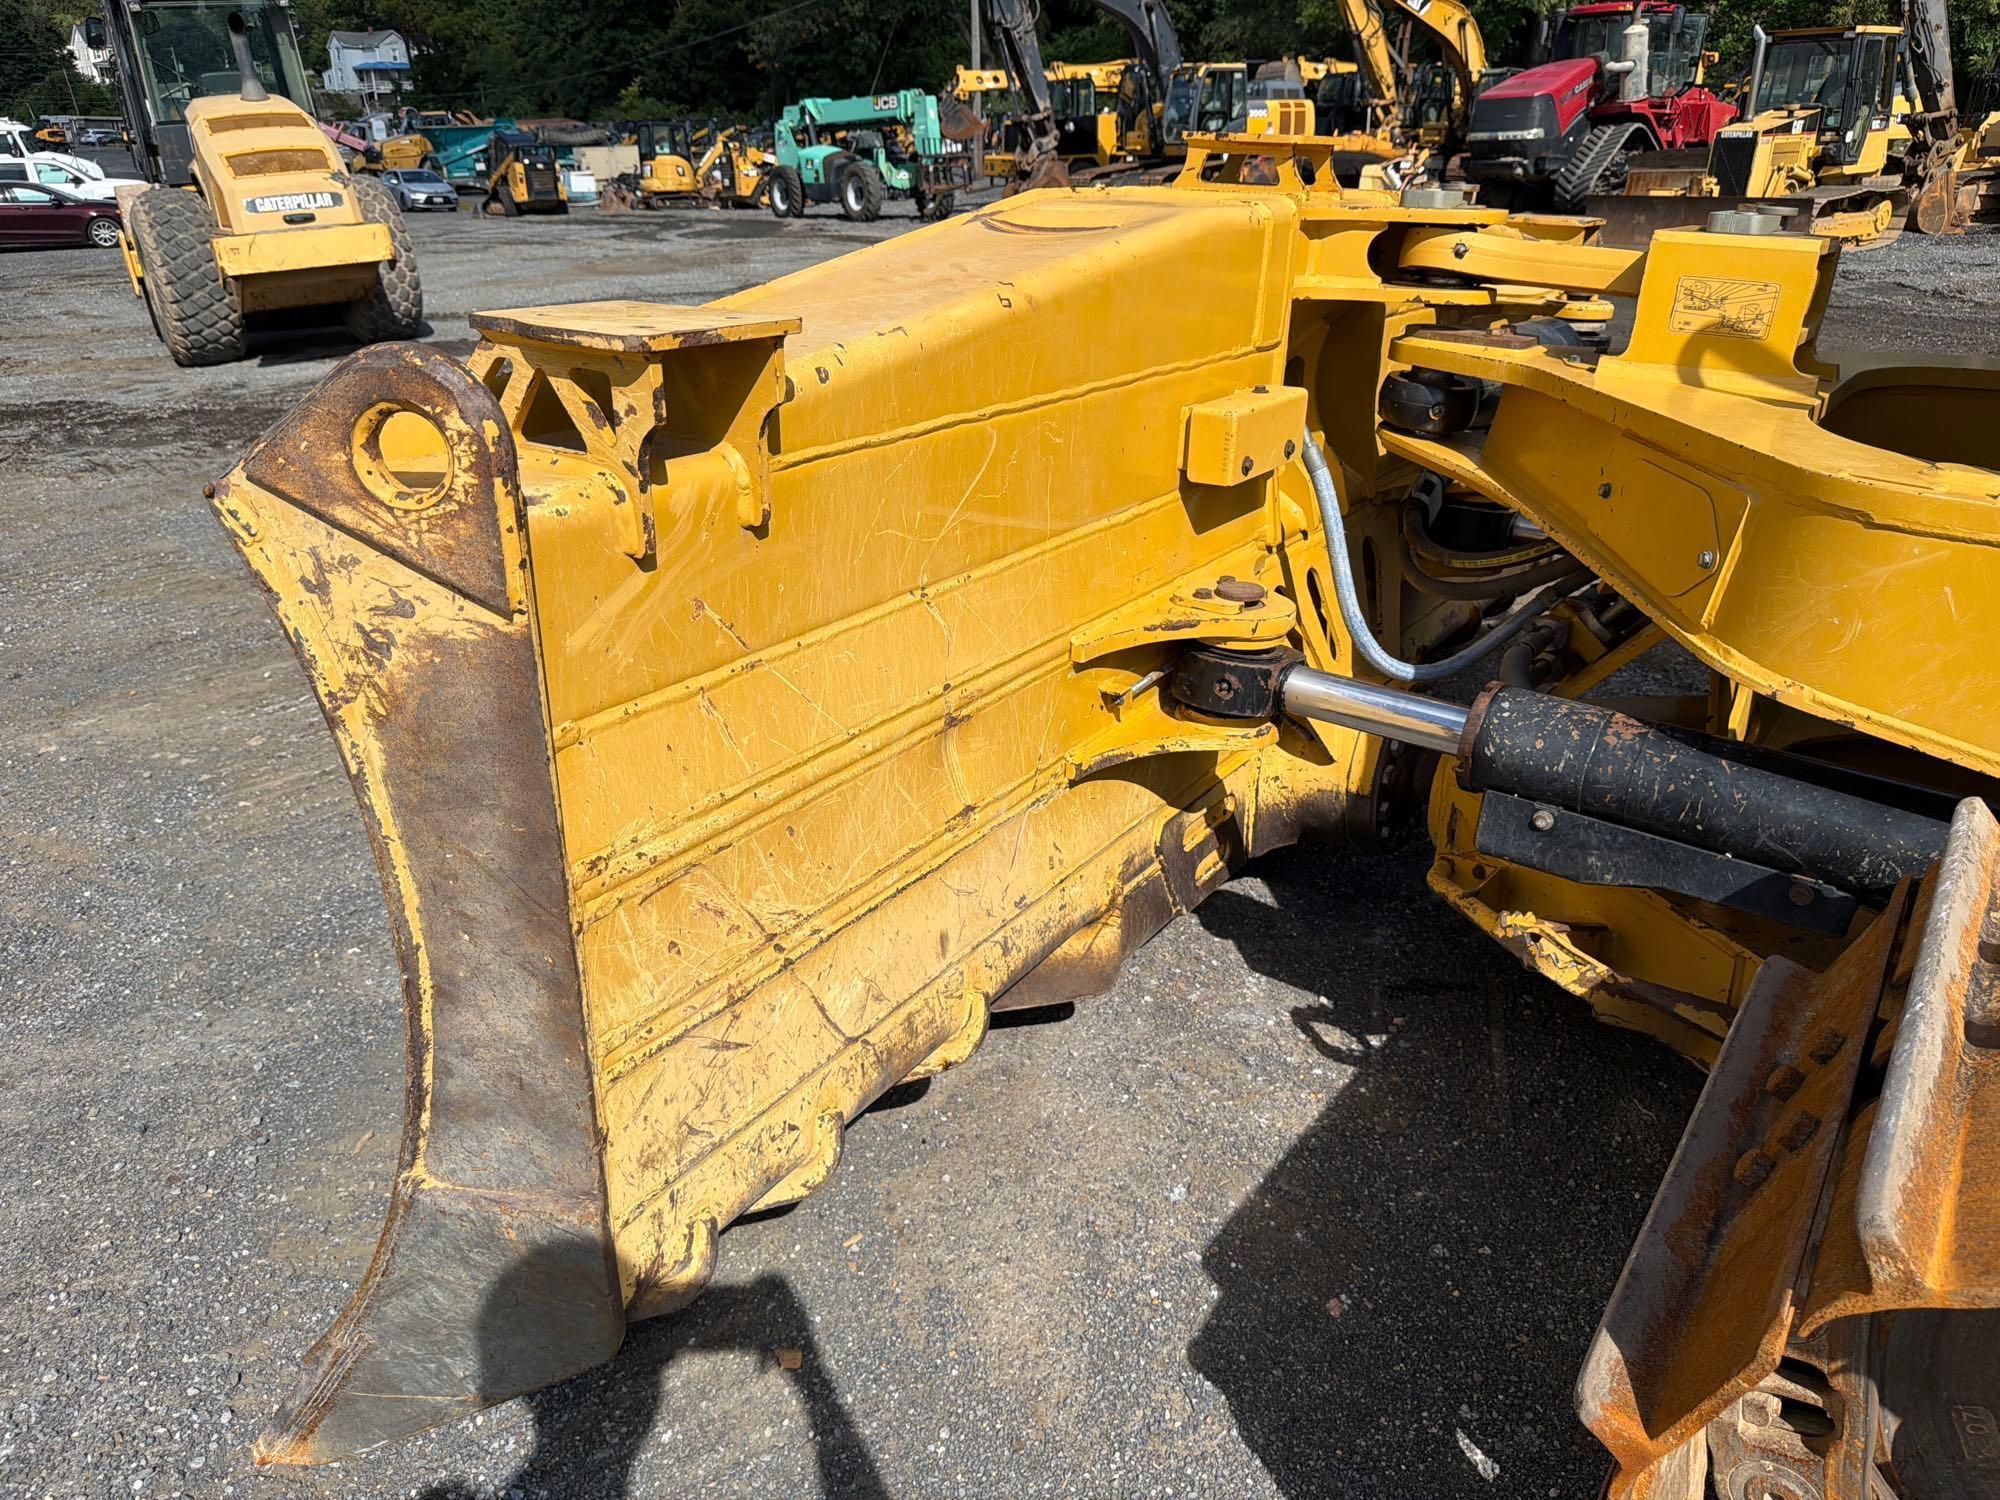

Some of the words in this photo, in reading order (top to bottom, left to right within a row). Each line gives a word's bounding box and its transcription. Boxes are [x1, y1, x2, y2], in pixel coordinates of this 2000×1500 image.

[874, 95, 898, 110] JCB
[1792, 119, 1805, 135] CAT
[1720, 131, 1754, 139] CATERPILLAR
[254, 192, 334, 212] CATERPILLAR
